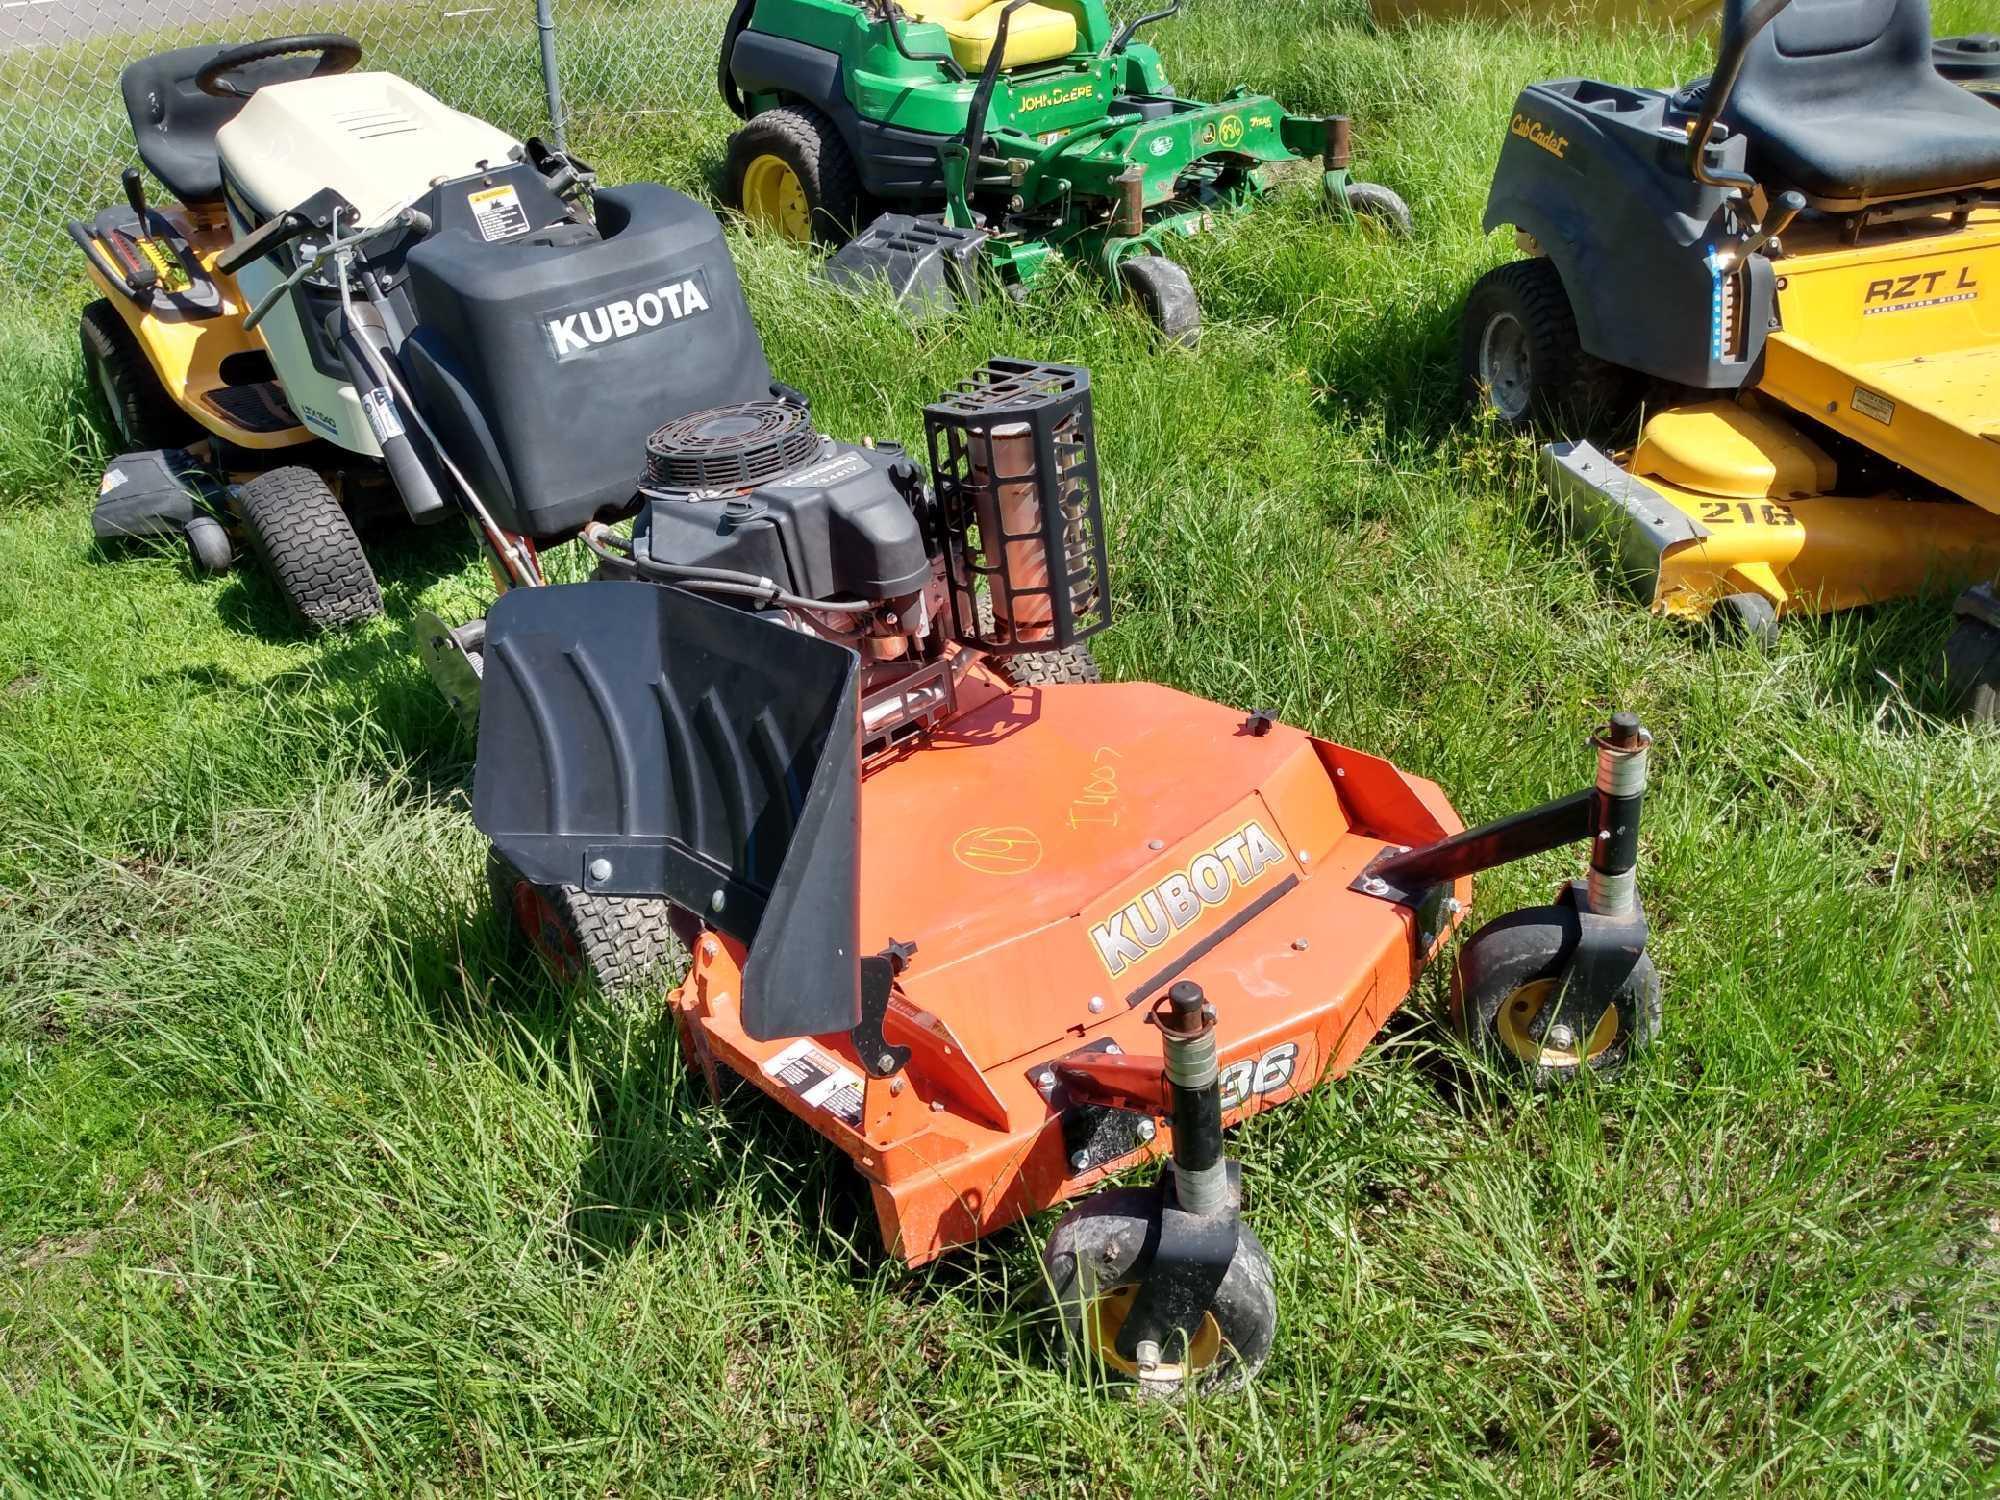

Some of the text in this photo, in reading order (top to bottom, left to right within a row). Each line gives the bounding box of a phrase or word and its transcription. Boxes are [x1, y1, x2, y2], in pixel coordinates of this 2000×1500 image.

[1018, 85, 1093, 113] JOHN DEERE
[1511, 113, 1569, 159] Cub Cadet
[1864, 266, 1978, 304] RZT L
[549, 279, 710, 355] KUBOTA
[1700, 502, 1796, 526] 216
[1090, 820, 1285, 977] KUBOTA
[1219, 1042, 1298, 1111] 36
